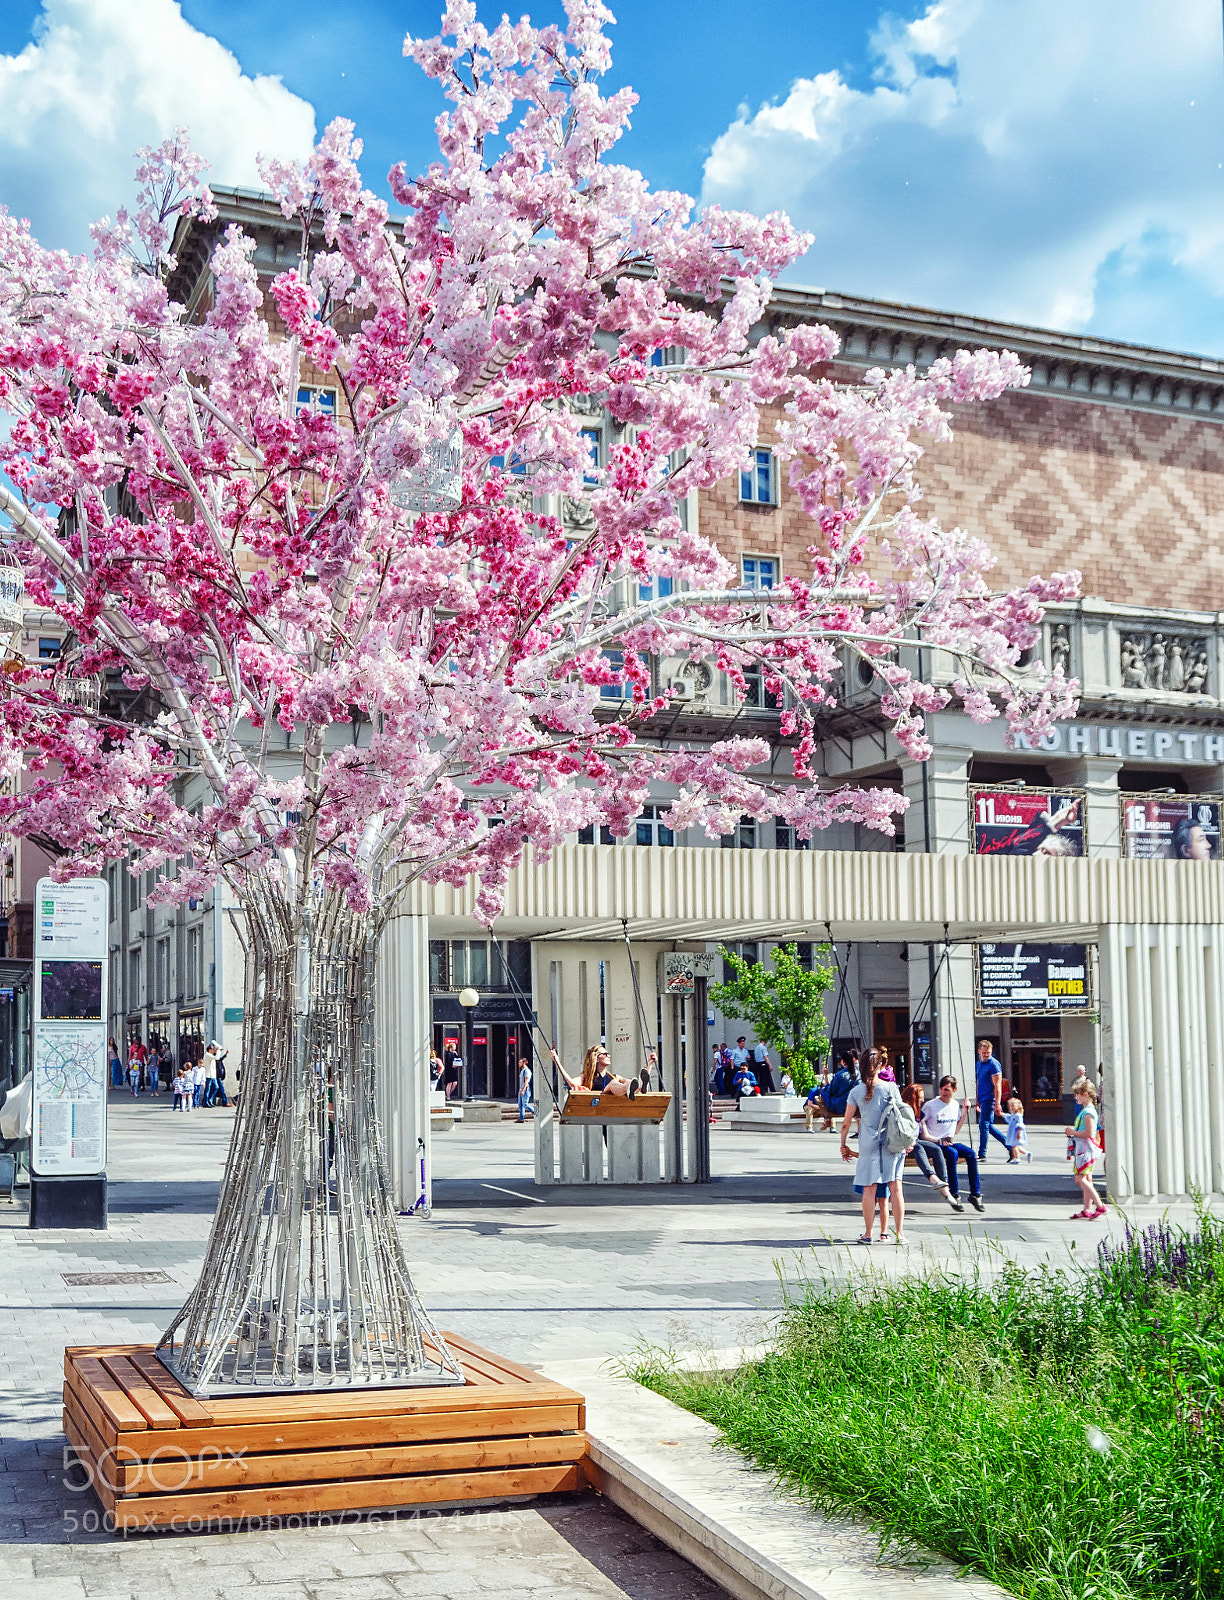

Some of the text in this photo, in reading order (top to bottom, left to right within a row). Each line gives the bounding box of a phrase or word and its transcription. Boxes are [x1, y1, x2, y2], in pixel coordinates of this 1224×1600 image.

[977, 797, 1023, 825] 11 ИЮНЯ
[1126, 805, 1146, 831] 15
[1146, 821, 1171, 830] ИЮНЯ
[1047, 965, 1085, 981] Валерий
[1048, 980, 1084, 995] ГЕРГИЕВ
